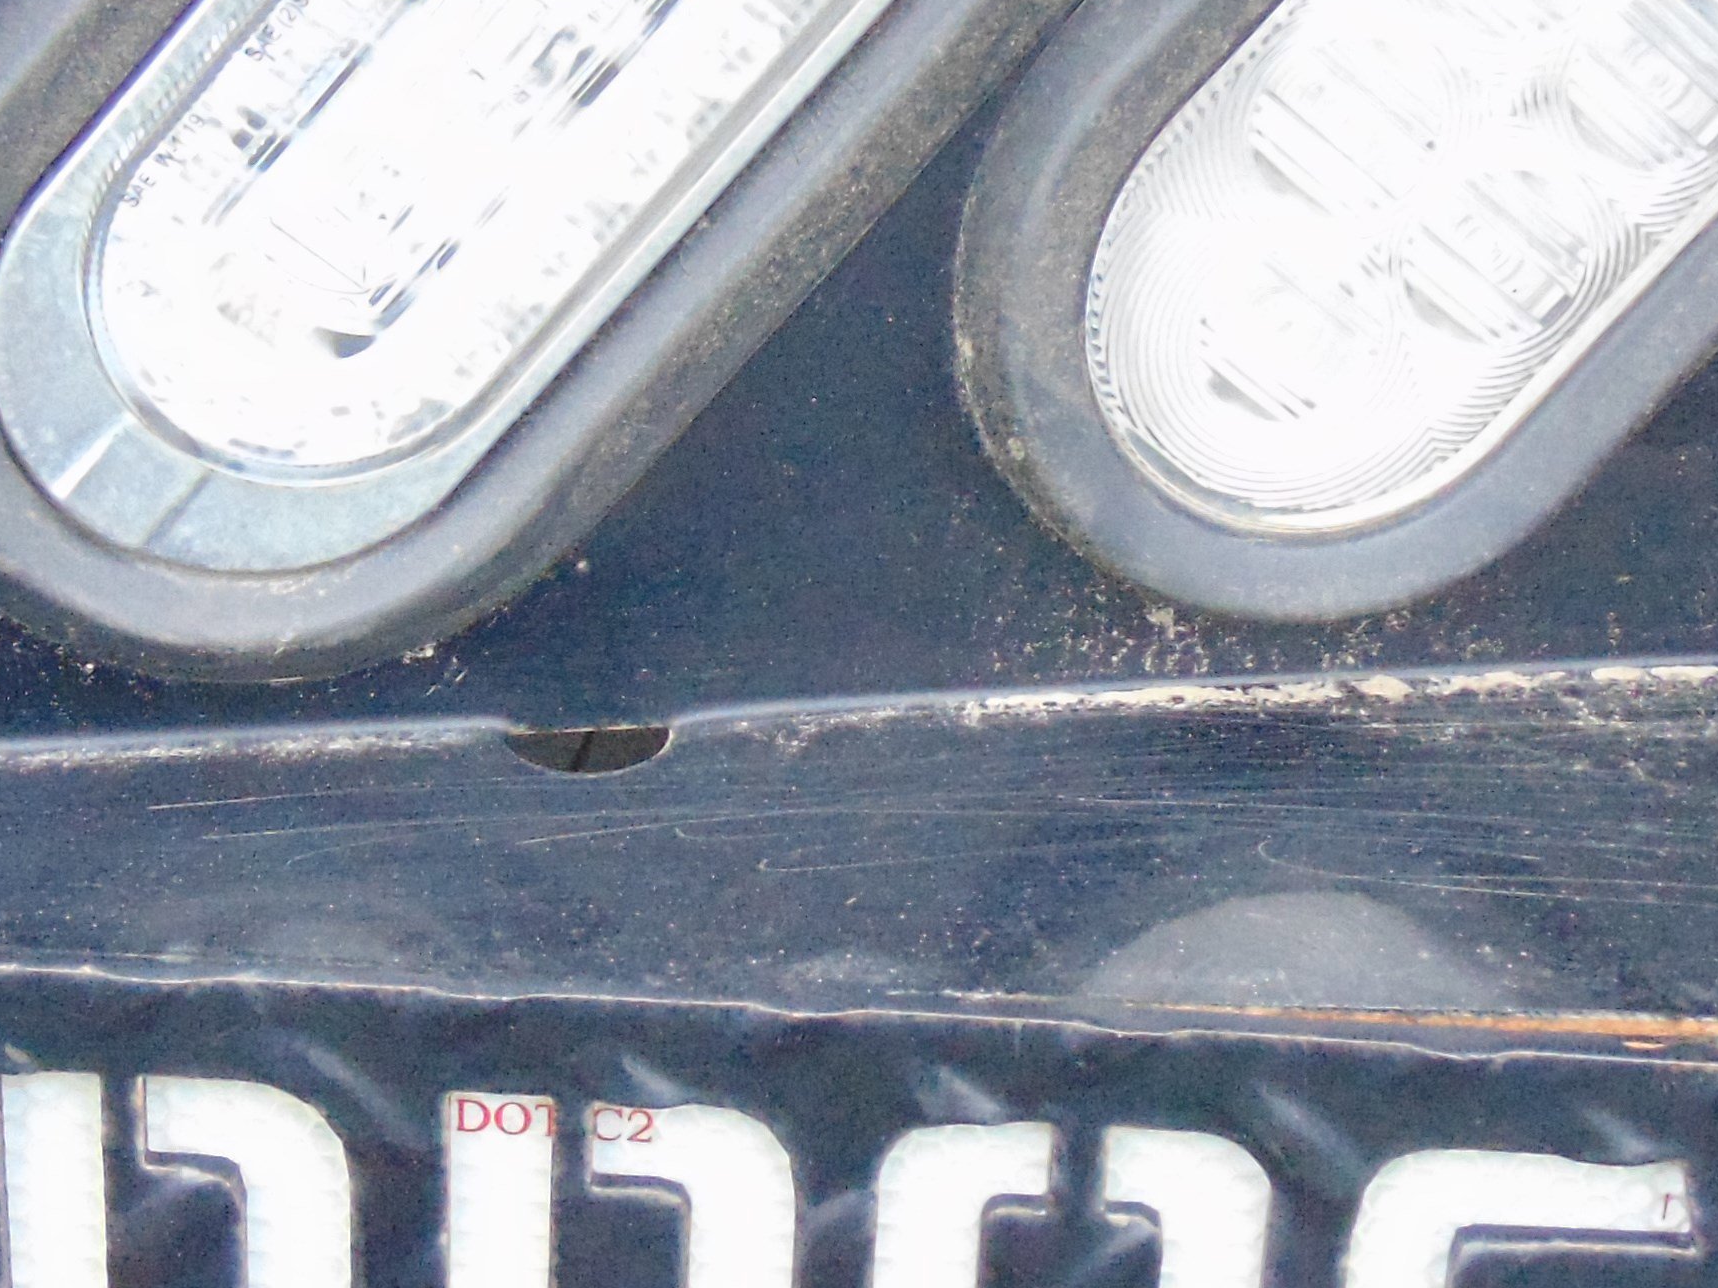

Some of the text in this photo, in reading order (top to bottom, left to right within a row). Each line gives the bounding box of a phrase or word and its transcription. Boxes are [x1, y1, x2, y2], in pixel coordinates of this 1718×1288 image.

[244, 24, 282, 62] SAE
[121, 173, 157, 208] SAE
[592, 1107, 655, 1143] C2
